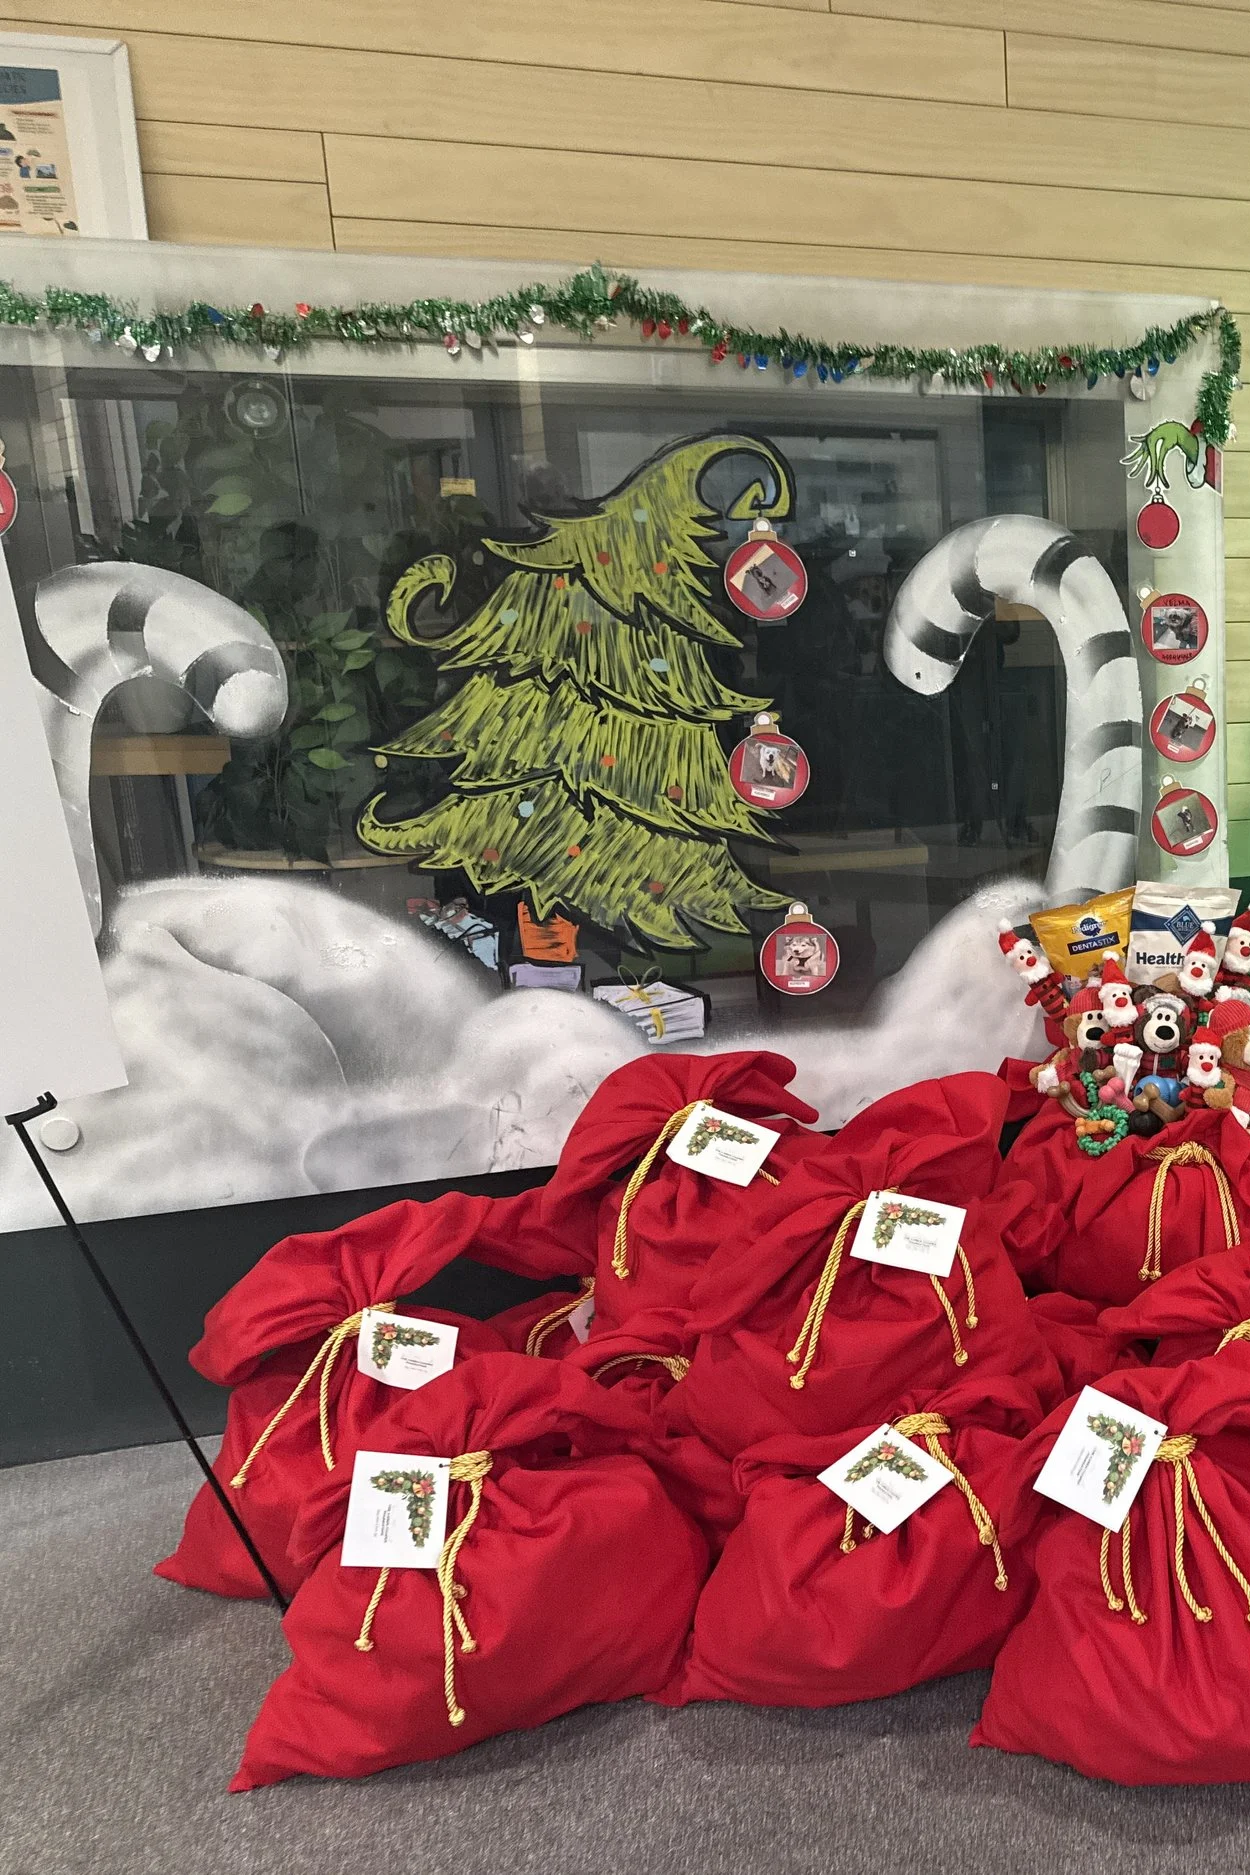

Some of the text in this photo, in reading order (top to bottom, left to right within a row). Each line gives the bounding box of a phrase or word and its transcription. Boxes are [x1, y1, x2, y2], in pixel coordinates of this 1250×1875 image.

[1176, 921, 1195, 929] BLUE
[1071, 935, 1116, 952] DENTASTIX
[1136, 951, 1185, 965] Health
